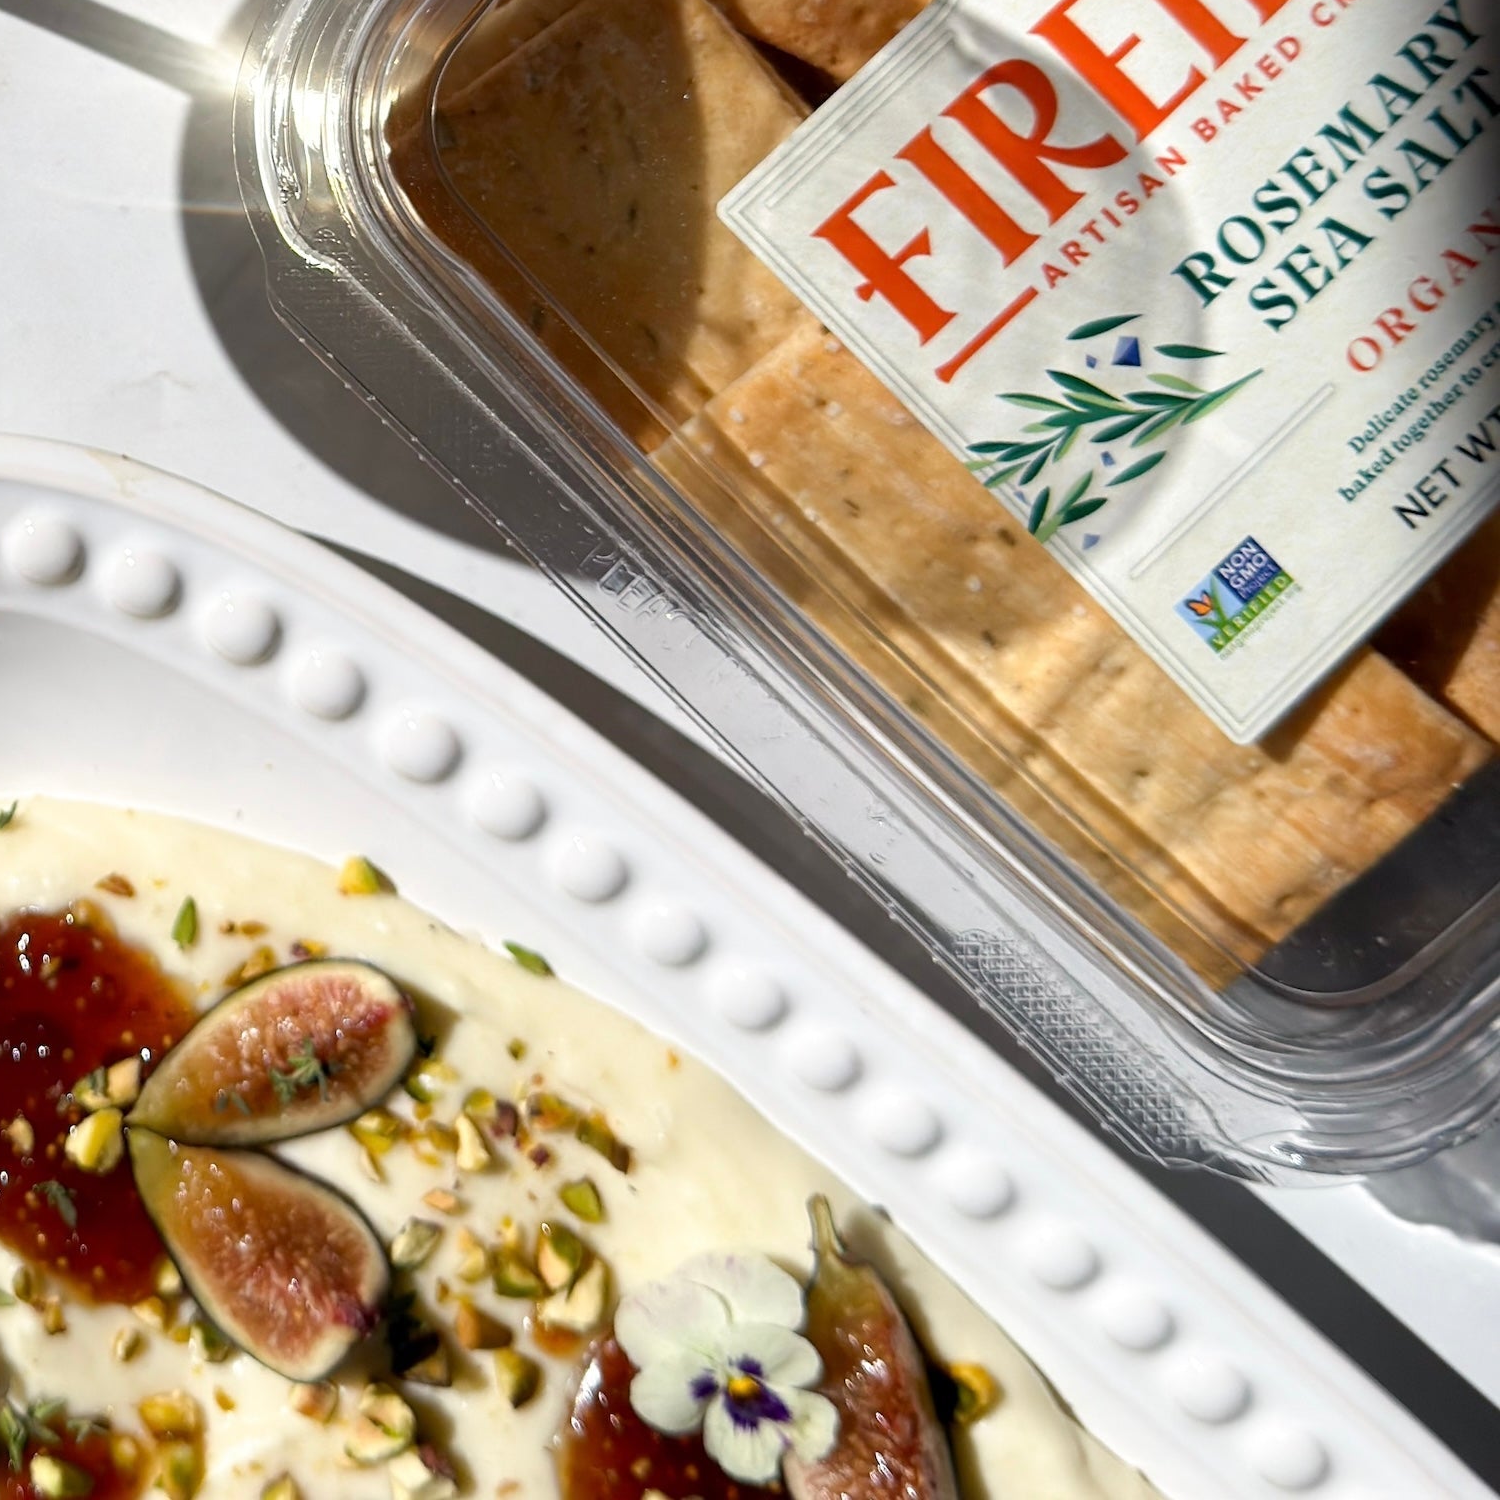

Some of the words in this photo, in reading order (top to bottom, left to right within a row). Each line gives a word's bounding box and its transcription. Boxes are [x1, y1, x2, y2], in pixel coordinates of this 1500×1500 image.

[1041, 146, 1188, 289] ARTISAN
[1190, 36, 1302, 143] BAKED
[1248, 216, 1377, 333] SEA
[1361, 65, 1500, 221] SALT
[1338, 448, 1396, 503] baked
[1391, 384, 1465, 453] together
[1459, 366, 1483, 387] to
[1346, 384, 1422, 454] Delicate
[1417, 310, 1495, 391] rosemary
[1392, 457, 1461, 530] NET
[1212, 575, 1288, 647] VERIFIED
[1218, 541, 1259, 580] NON
[1228, 552, 1269, 590] GMO
